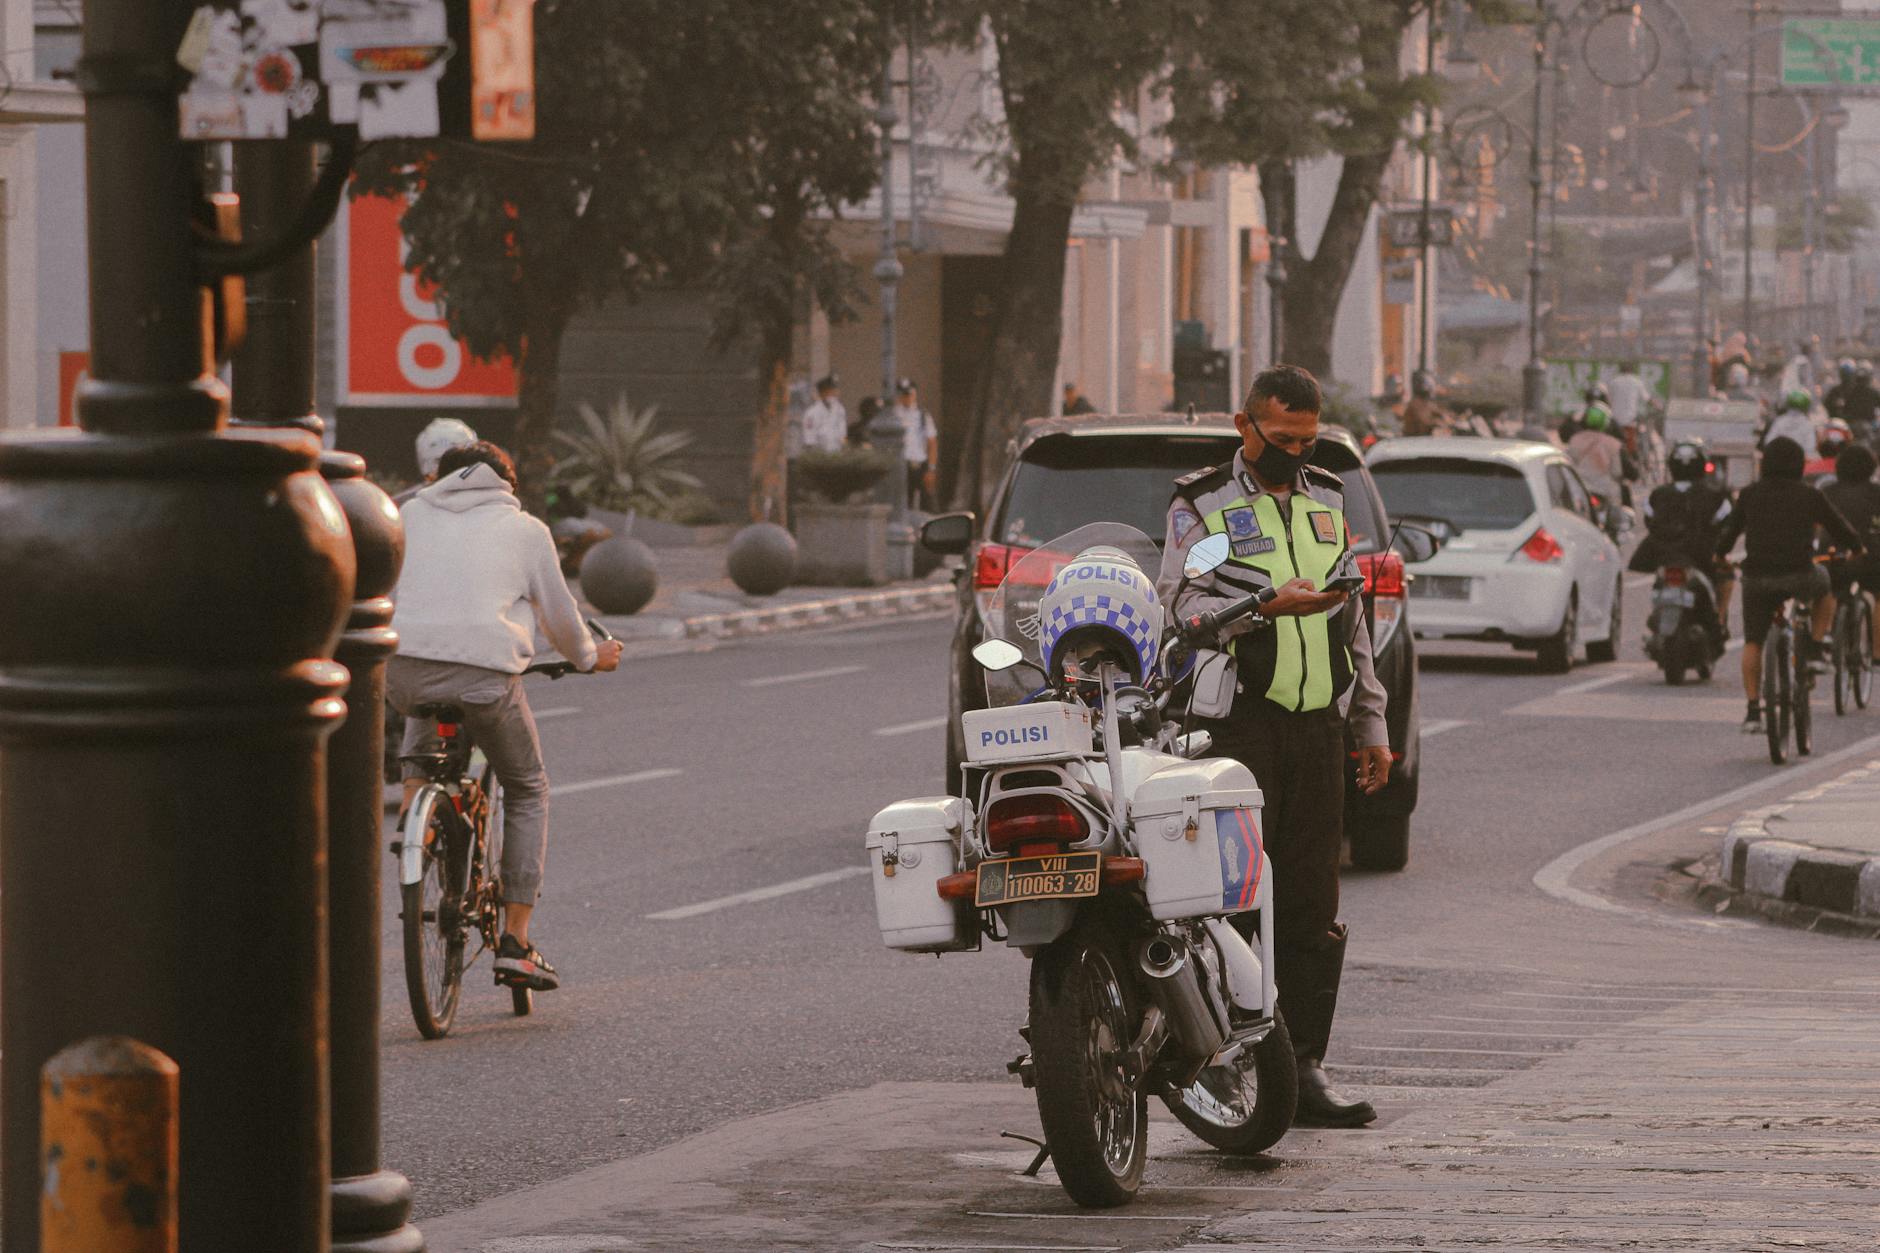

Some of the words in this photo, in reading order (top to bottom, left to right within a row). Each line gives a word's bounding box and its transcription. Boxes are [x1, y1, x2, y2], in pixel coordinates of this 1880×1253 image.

[1235, 540, 1275, 556] NURHADI
[1062, 566, 1138, 590] POLISI
[981, 726, 1048, 747] POLISI
[1040, 858, 1067, 871] VIII
